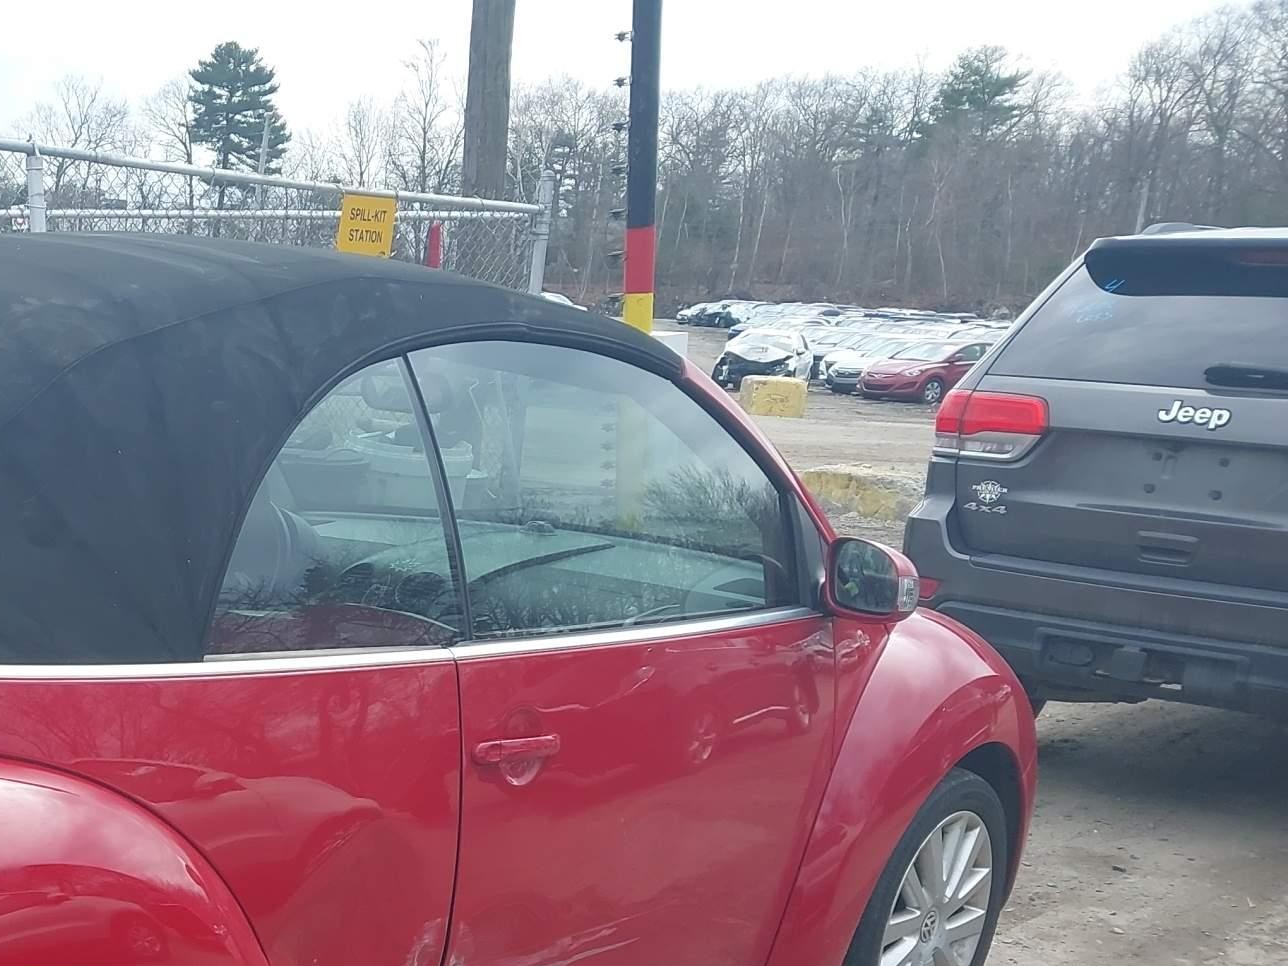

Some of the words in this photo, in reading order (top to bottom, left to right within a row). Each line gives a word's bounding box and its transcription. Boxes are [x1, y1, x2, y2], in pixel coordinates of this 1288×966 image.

[349, 207, 387, 223] SPILL-KIT
[348, 228, 383, 244] STATION
[1158, 400, 1231, 430] Jeep
